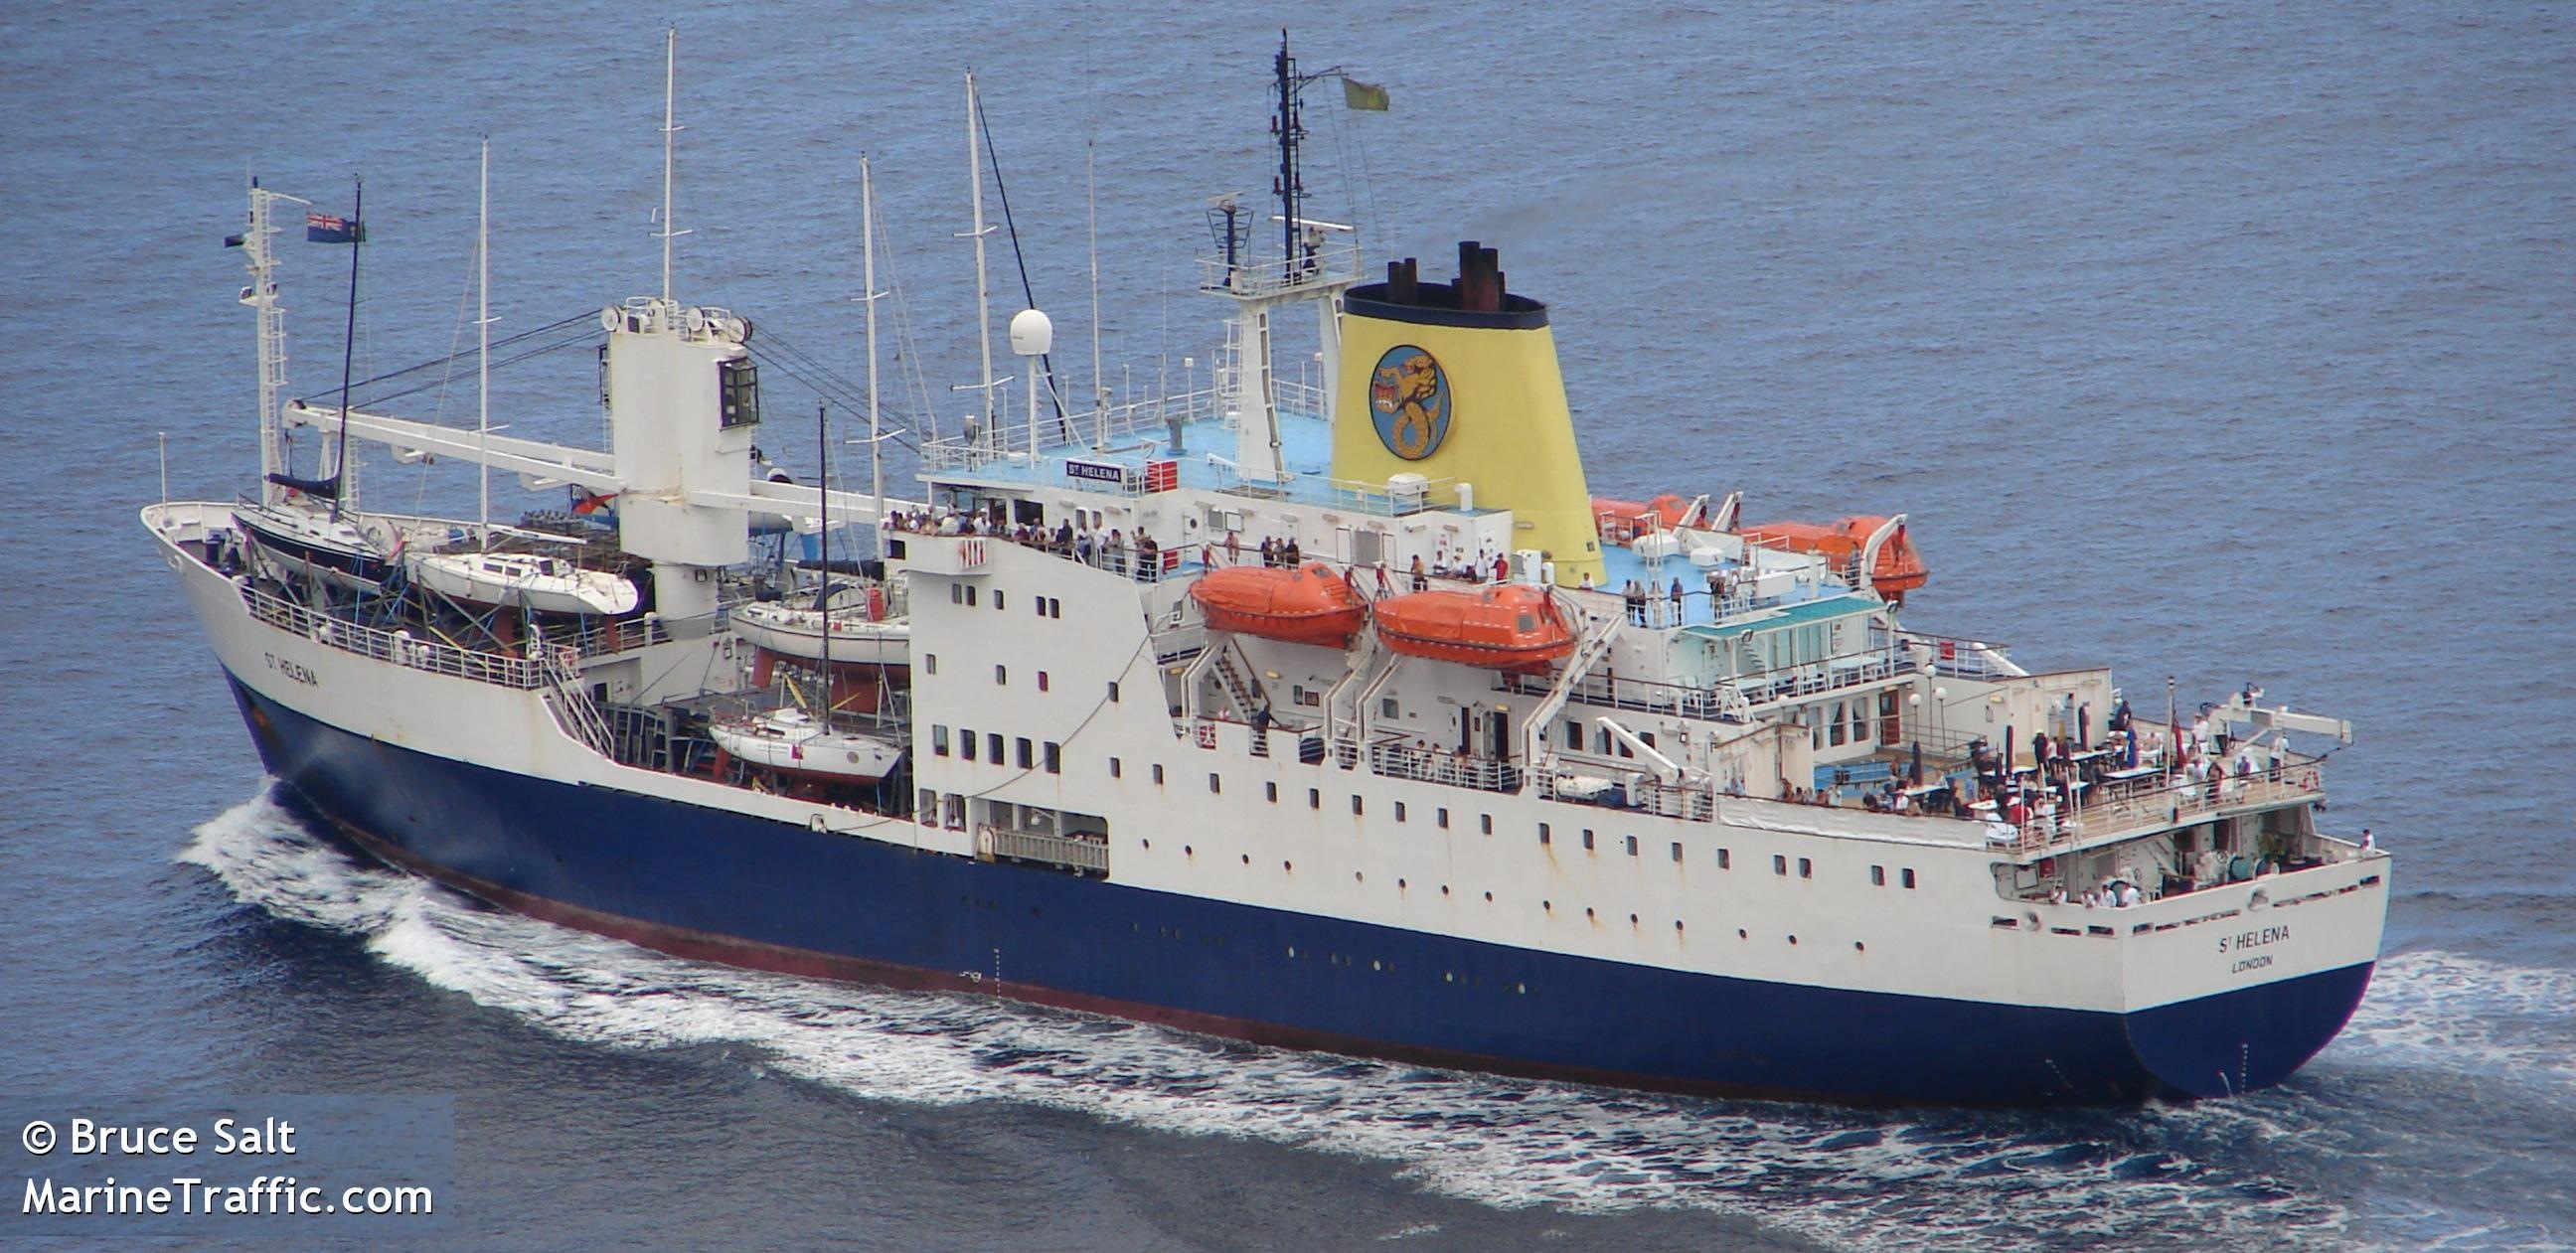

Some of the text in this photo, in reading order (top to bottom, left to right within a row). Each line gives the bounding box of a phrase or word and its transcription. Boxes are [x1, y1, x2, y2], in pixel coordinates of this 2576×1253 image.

[1081, 465, 1119, 481] HELENA
[277, 657, 319, 688] HELENA
[2236, 925, 2290, 950] HELENA
[2232, 955, 2274, 974] LONDON
